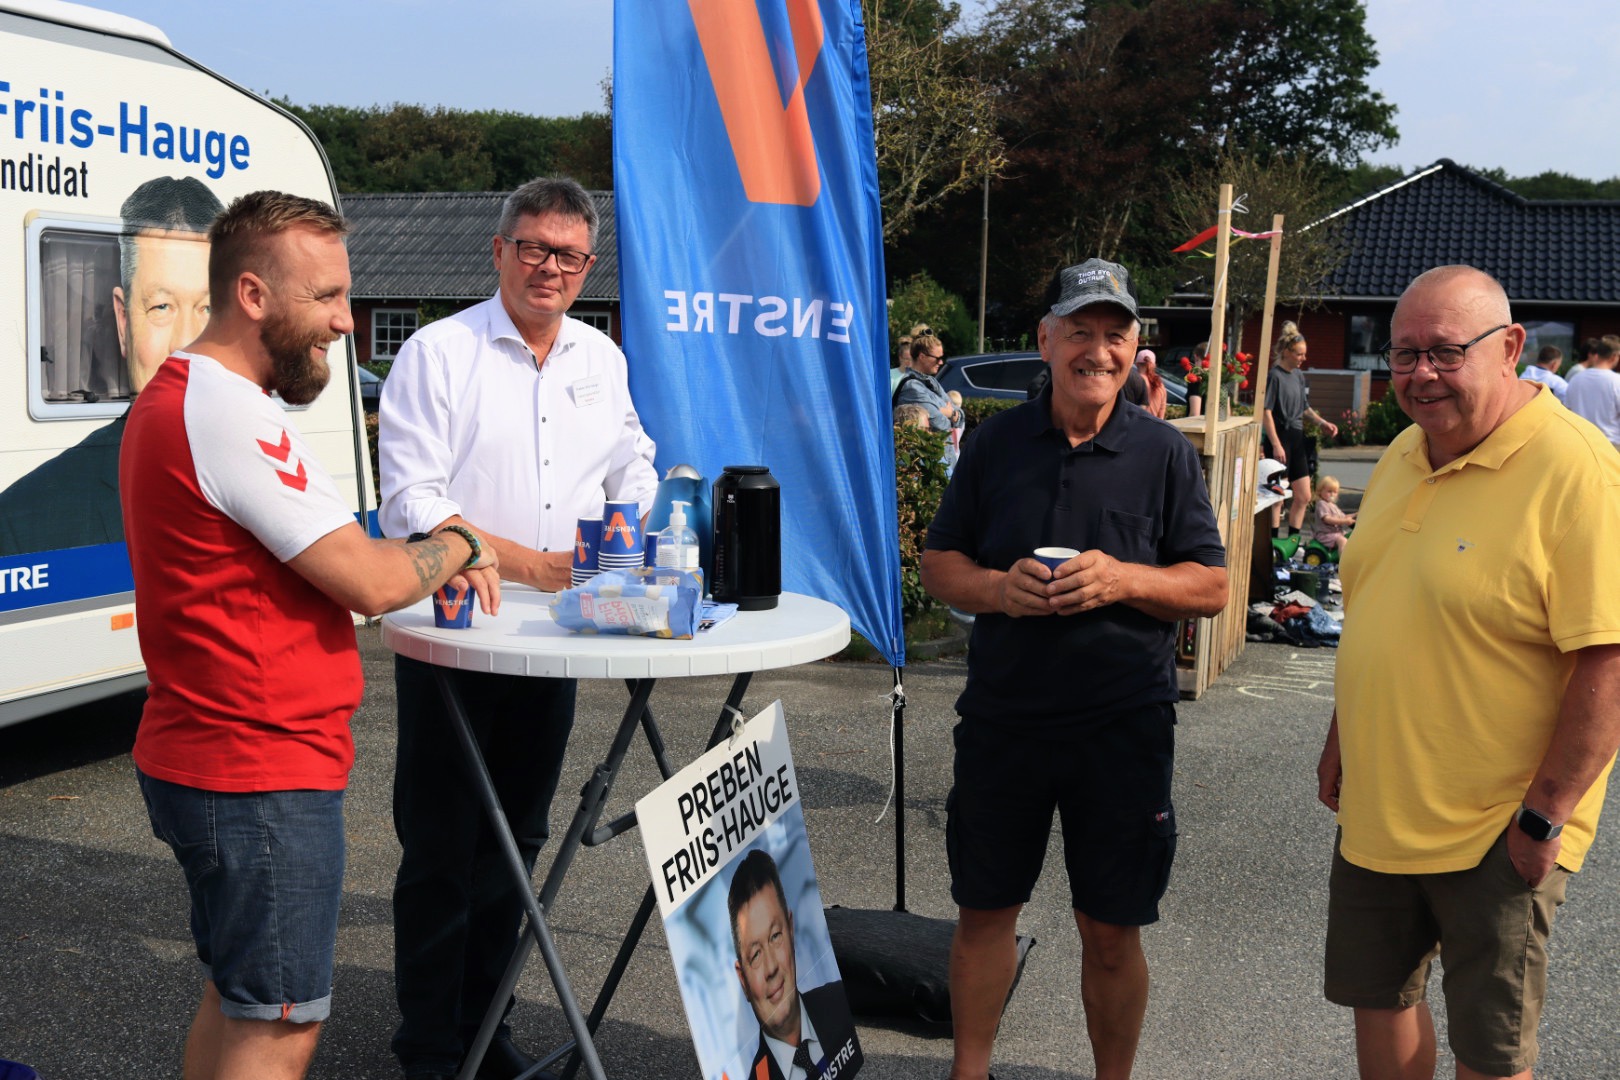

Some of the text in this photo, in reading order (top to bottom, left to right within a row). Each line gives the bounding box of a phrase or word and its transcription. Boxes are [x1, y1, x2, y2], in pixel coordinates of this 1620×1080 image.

[1, 152, 88, 198] ndidat
[661, 764, 793, 903] FRIIS-HAUGE
[677, 740, 764, 836] PREBEN
